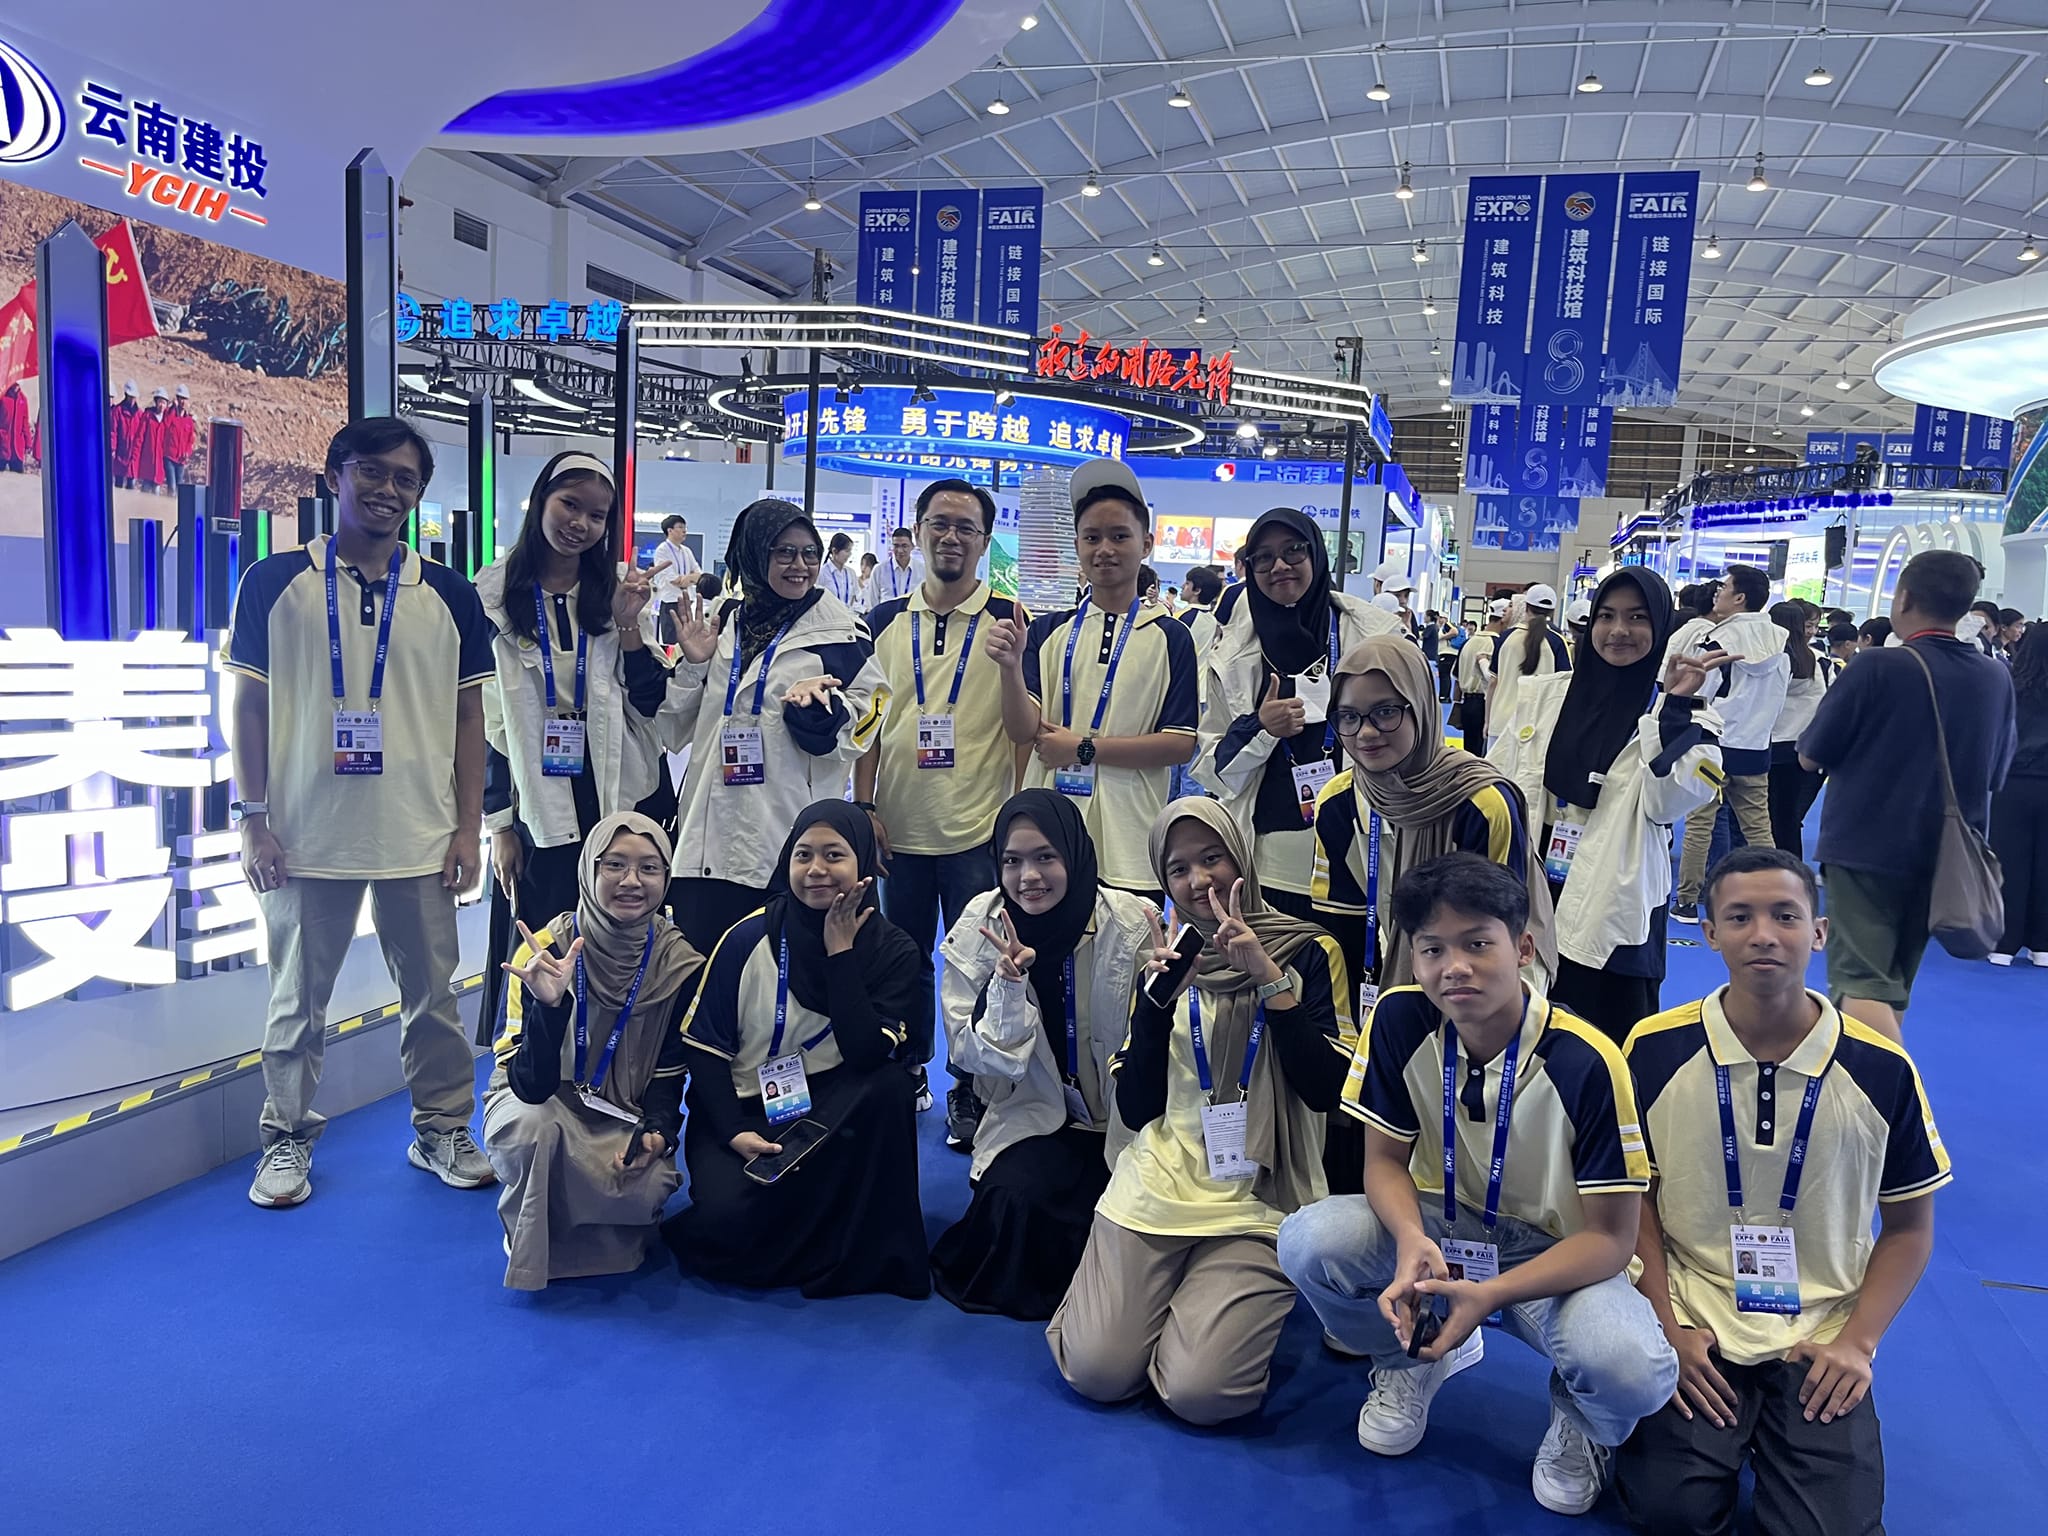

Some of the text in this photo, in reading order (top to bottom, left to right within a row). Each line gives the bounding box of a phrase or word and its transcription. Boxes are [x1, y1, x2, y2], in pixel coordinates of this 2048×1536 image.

[81, 81, 268, 199] 云南建投
[127, 162, 230, 221] YCIH
[988, 210, 1036, 224] FAIR
[1474, 201, 1531, 216] EXPO
[1629, 196, 1688, 212] FAIR
[865, 214, 911, 227] EXPO
[939, 239, 958, 319] 建筑科技馆
[1005, 246, 1023, 325] 链接国际
[1486, 239, 1510, 325] 建筑科技
[1563, 228, 1589, 320] 建筑科技馆
[1644, 236, 1670, 325] 链接国际
[440, 297, 623, 342] 追求卓越
[900, 407, 1030, 444] 勇于跨越
[1049, 420, 1123, 460] 追求卓越
[1534, 405, 1550, 443] 科技馆
[1320, 508, 1360, 519] 中国铁
